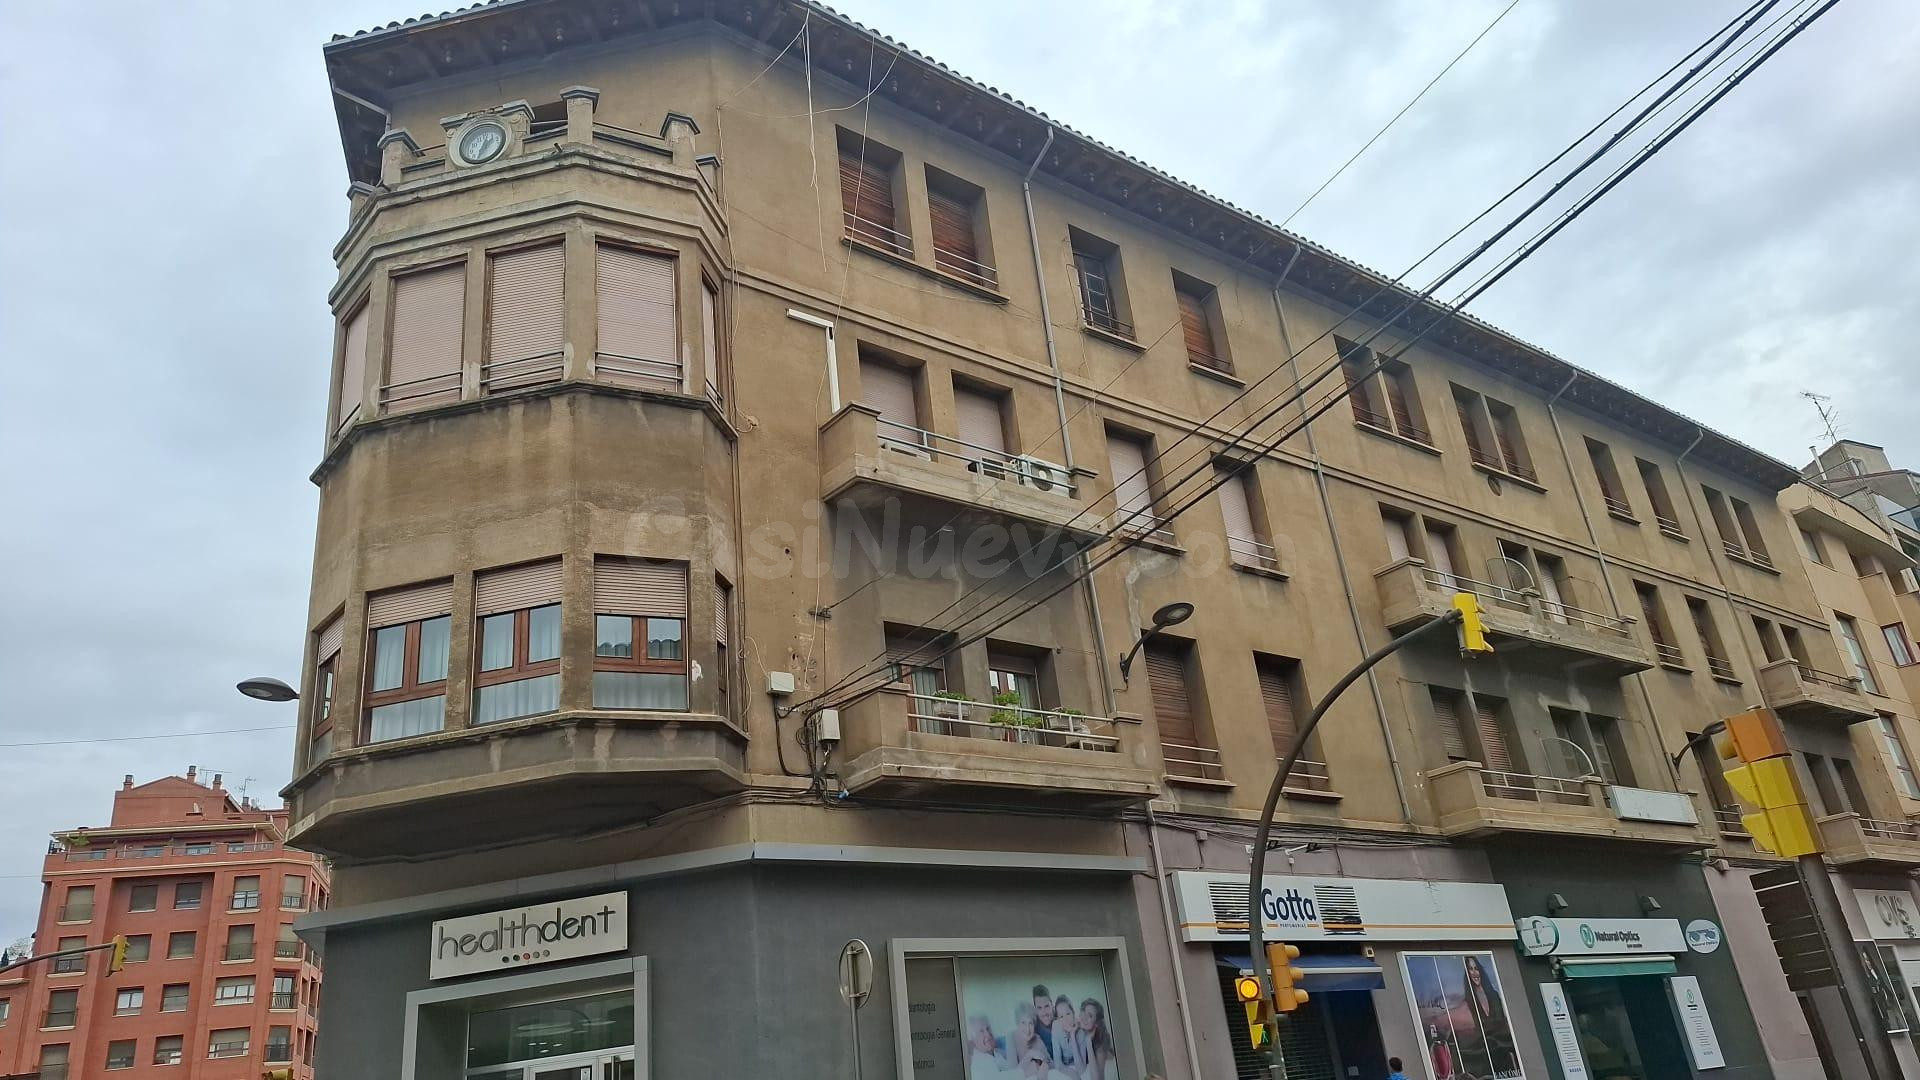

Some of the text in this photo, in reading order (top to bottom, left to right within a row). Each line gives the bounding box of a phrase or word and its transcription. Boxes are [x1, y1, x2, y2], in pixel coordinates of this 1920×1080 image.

[1262, 888, 1317, 921] Gotta
[438, 905, 616, 960] healthdent
[1594, 930, 1640, 943] Natural Optics
